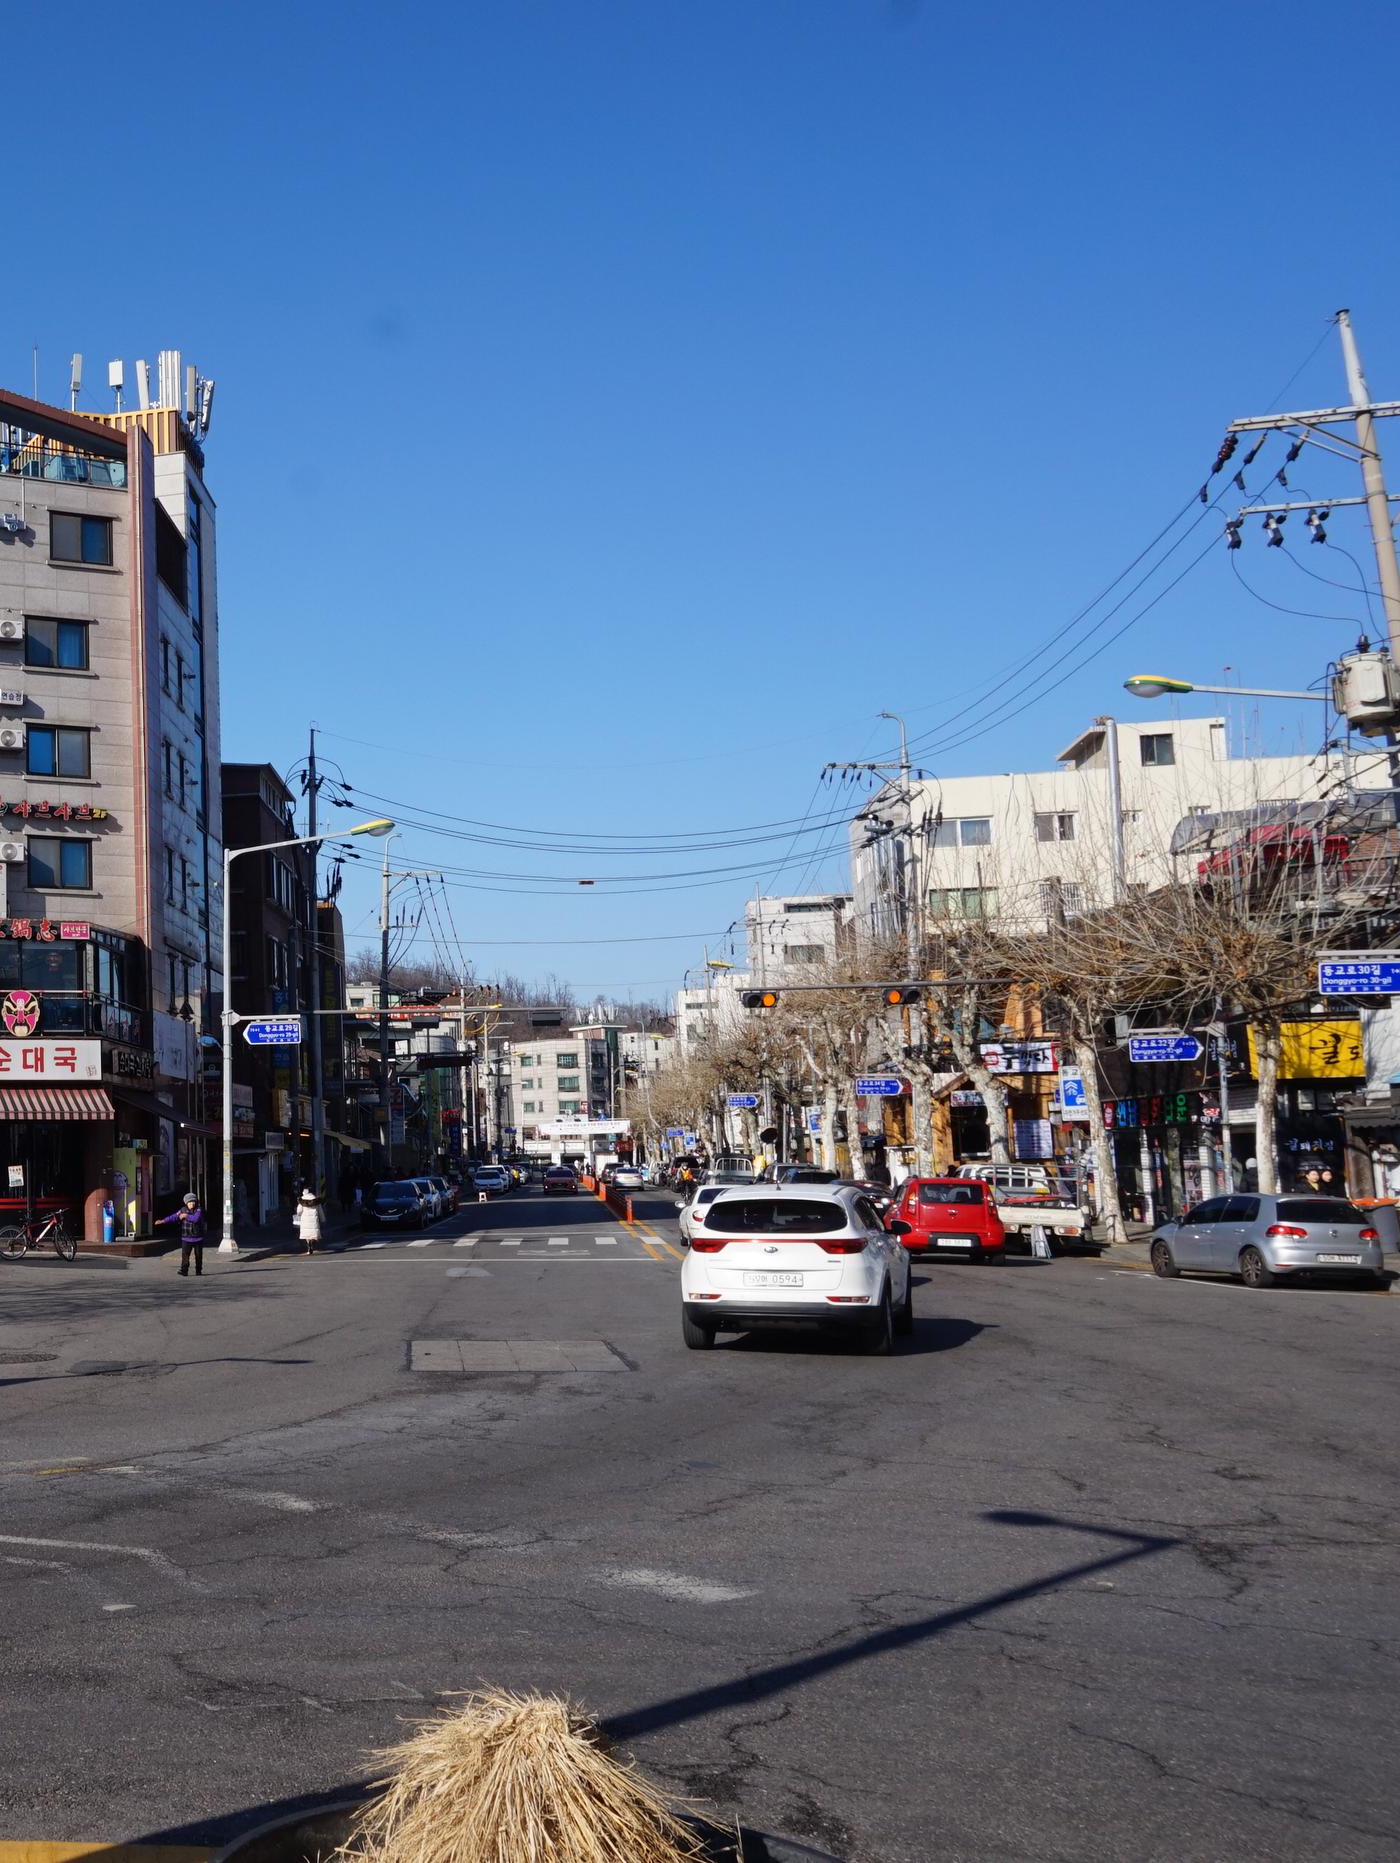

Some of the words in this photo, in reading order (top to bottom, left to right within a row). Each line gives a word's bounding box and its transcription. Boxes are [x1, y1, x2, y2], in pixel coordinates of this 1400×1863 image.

[12, 800, 92, 821] 샤브샤브
[1322, 965, 1381, 976] 동교로30길
[1322, 977, 1368, 986] Donggyo-ro
[1369, 976, 1392, 985] 30-gil
[264, 1024, 298, 1032] 동교로29길
[1131, 1039, 1176, 1048] 동교로32길
[771, 1274, 799, 1285] 0594
